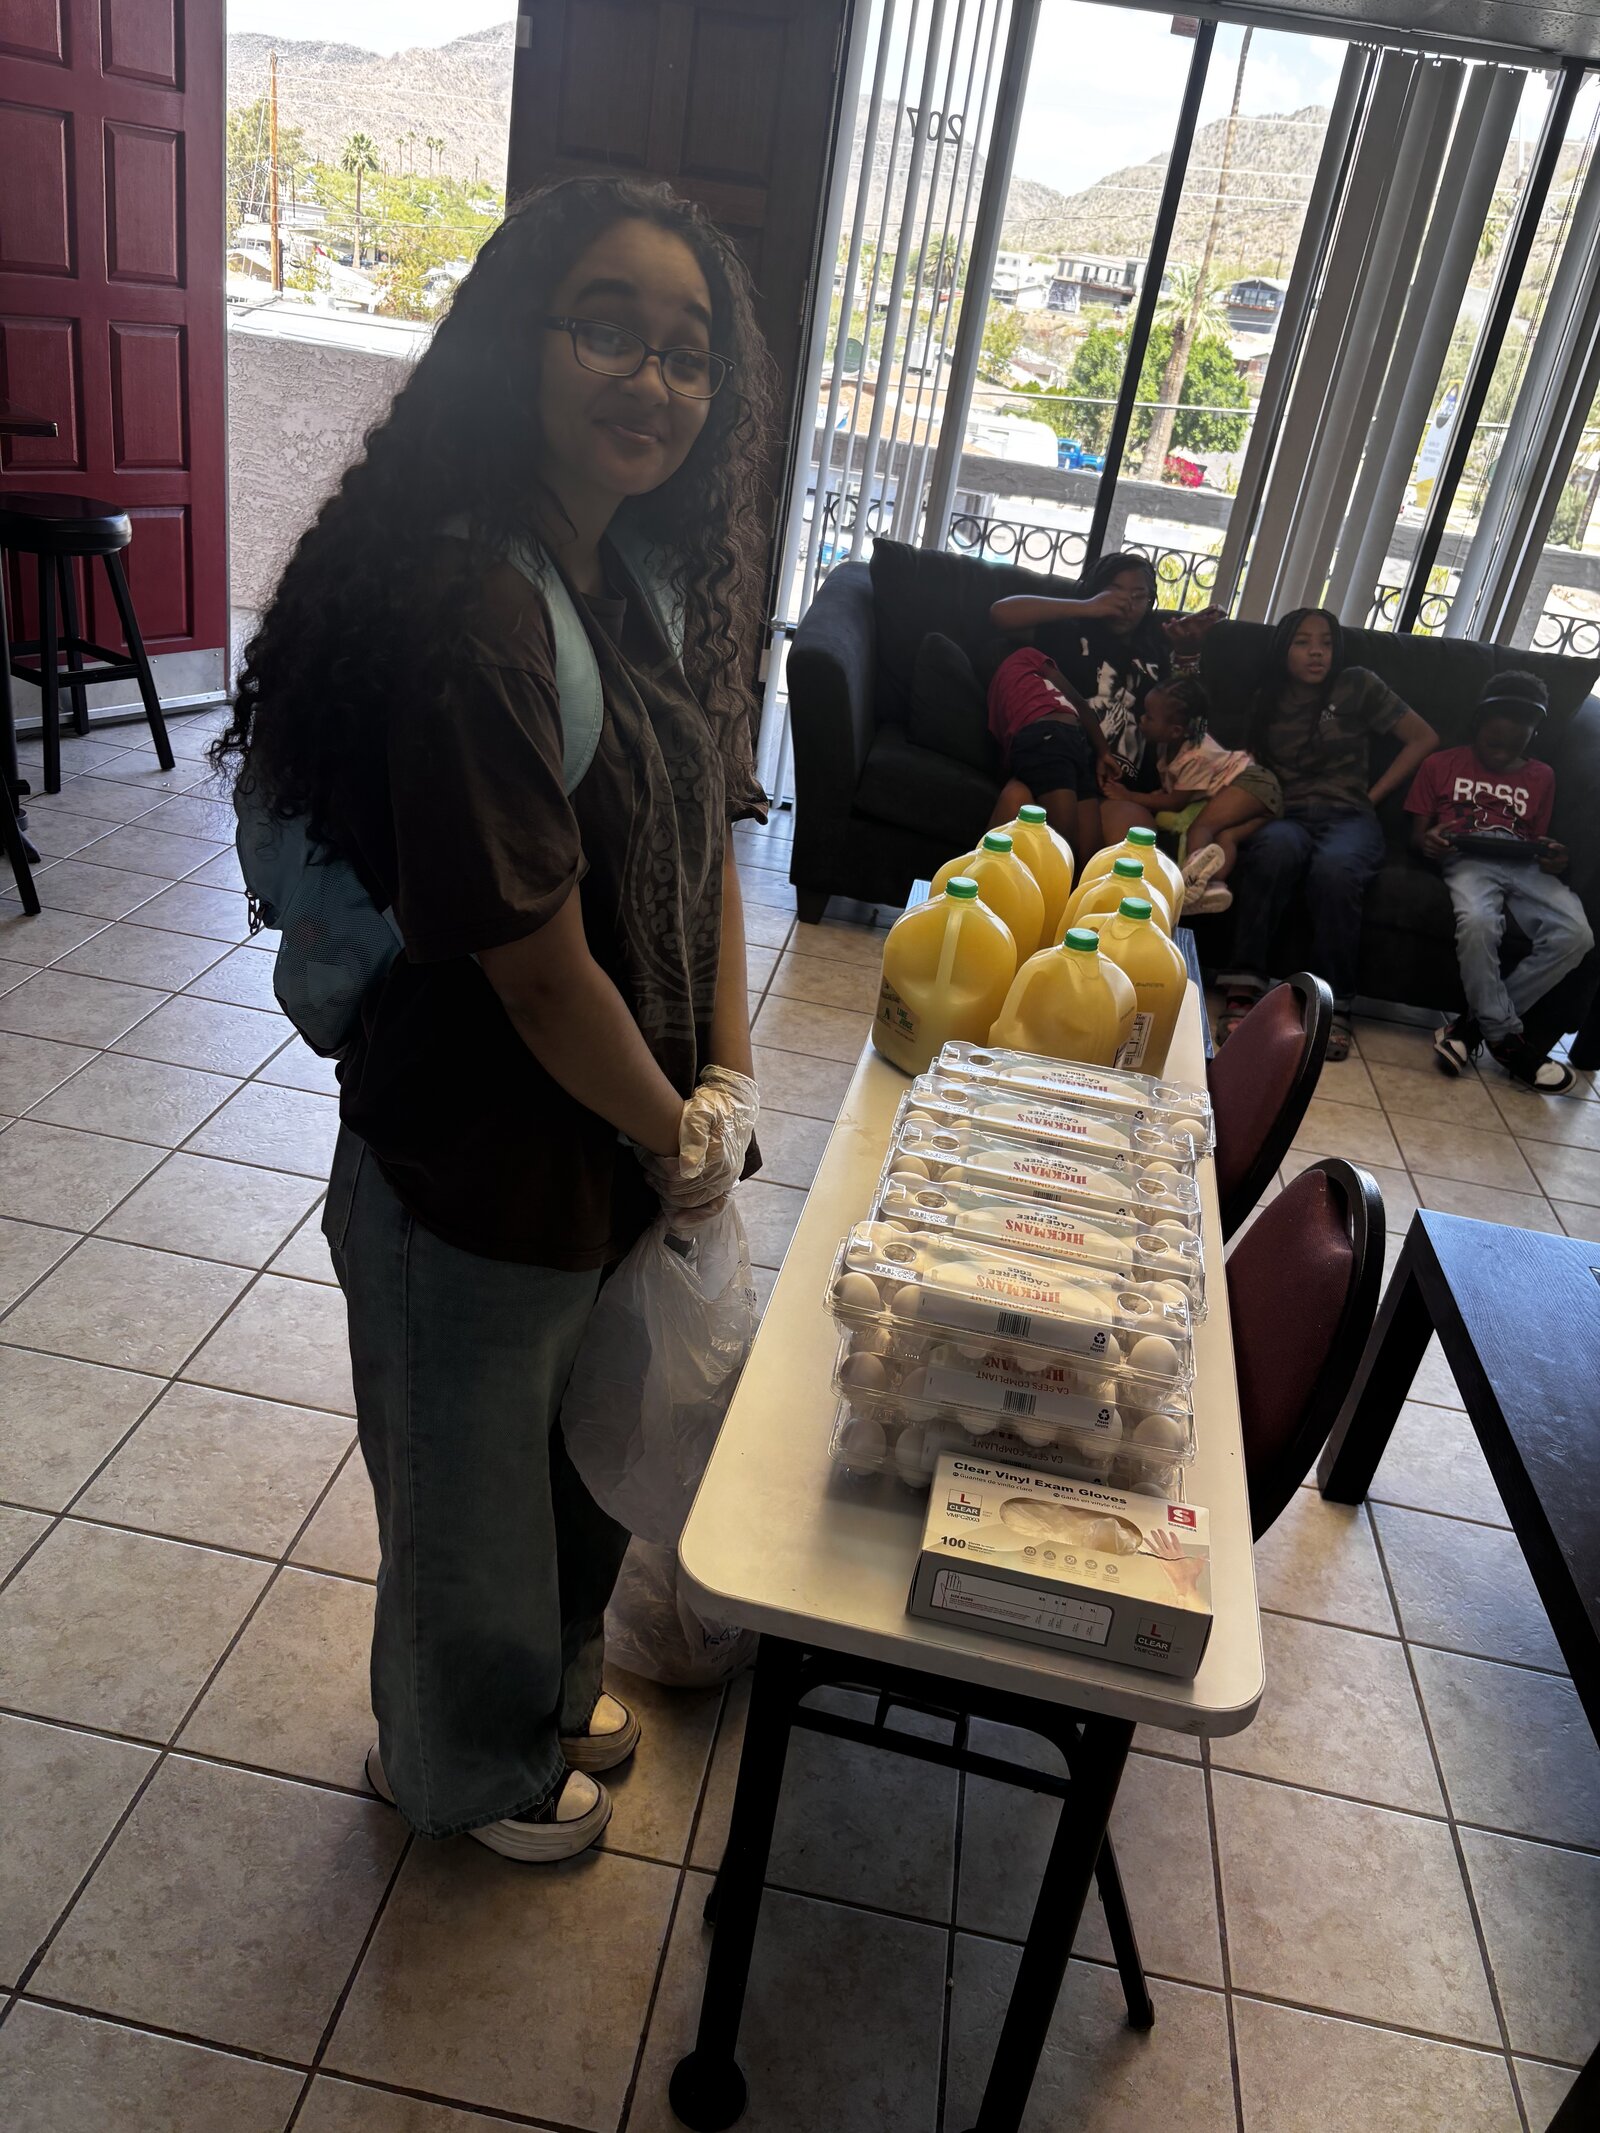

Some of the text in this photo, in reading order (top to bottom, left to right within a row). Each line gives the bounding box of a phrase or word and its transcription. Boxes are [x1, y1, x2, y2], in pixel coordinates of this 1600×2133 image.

[1023, 1157, 1078, 1173] CAGE FREE
[1016, 1213, 1075, 1230] CAGE FREE
[988, 1268, 1018, 1279] FREE
[1007, 1267, 1032, 1276] EGGS
[1019, 1275, 1050, 1288] CAGE
[975, 1370, 1030, 1388] COMPLIANT
[1056, 1387, 1070, 1395] CA
[971, 1439, 1025, 1457] COMPLIANT
[1051, 1455, 1064, 1464] CA
[954, 1462, 1127, 1505] Clear Vinyl Exam Gloves
[959, 1473, 987, 1483] Guantes
[960, 1493, 970, 1504] L
[949, 1504, 978, 1515] CLEAR
[941, 1536, 966, 1549] 100
[1150, 1623, 1161, 1638] L
[1137, 1637, 1169, 1651] CLEAR
